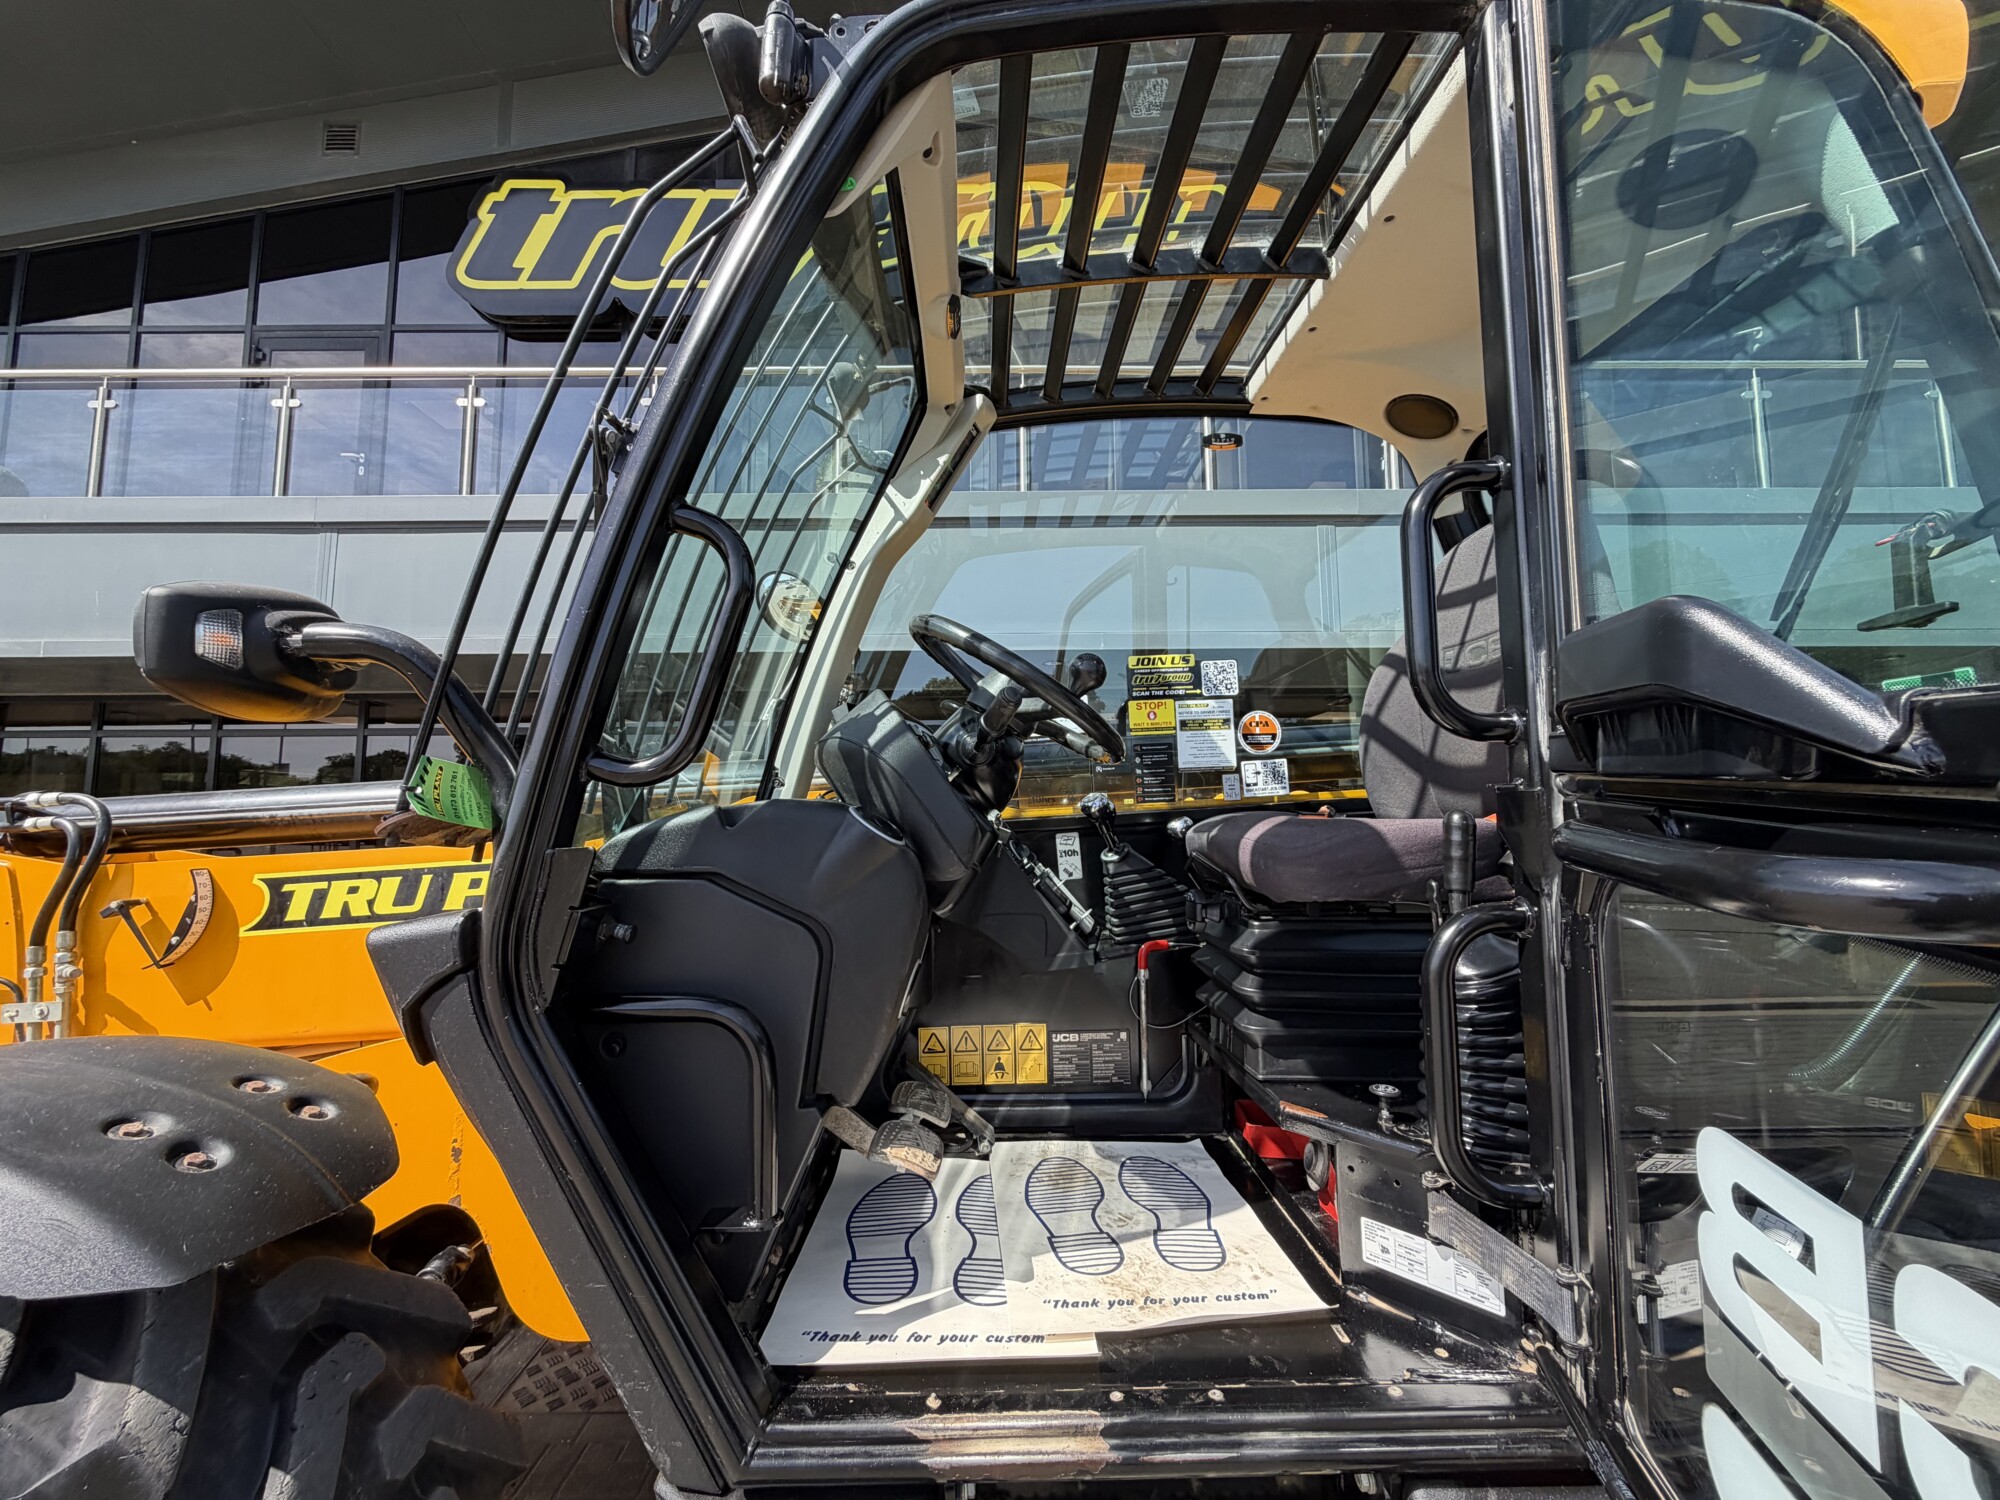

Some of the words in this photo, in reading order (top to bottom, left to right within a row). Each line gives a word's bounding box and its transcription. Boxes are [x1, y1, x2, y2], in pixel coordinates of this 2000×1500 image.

[1132, 657, 1167, 667] JOIN
[1171, 656, 1191, 665] US
[1136, 701, 1167, 710] STOP!
[281, 874, 433, 921] TRU
[1052, 1033, 1079, 1042] JCB
[1107, 1298, 1135, 1310] you
[1143, 1295, 1165, 1306] for
[1173, 1294, 1208, 1306] your
[866, 1332, 899, 1345] you
[907, 1331, 932, 1343] for
[937, 1333, 978, 1346] your
